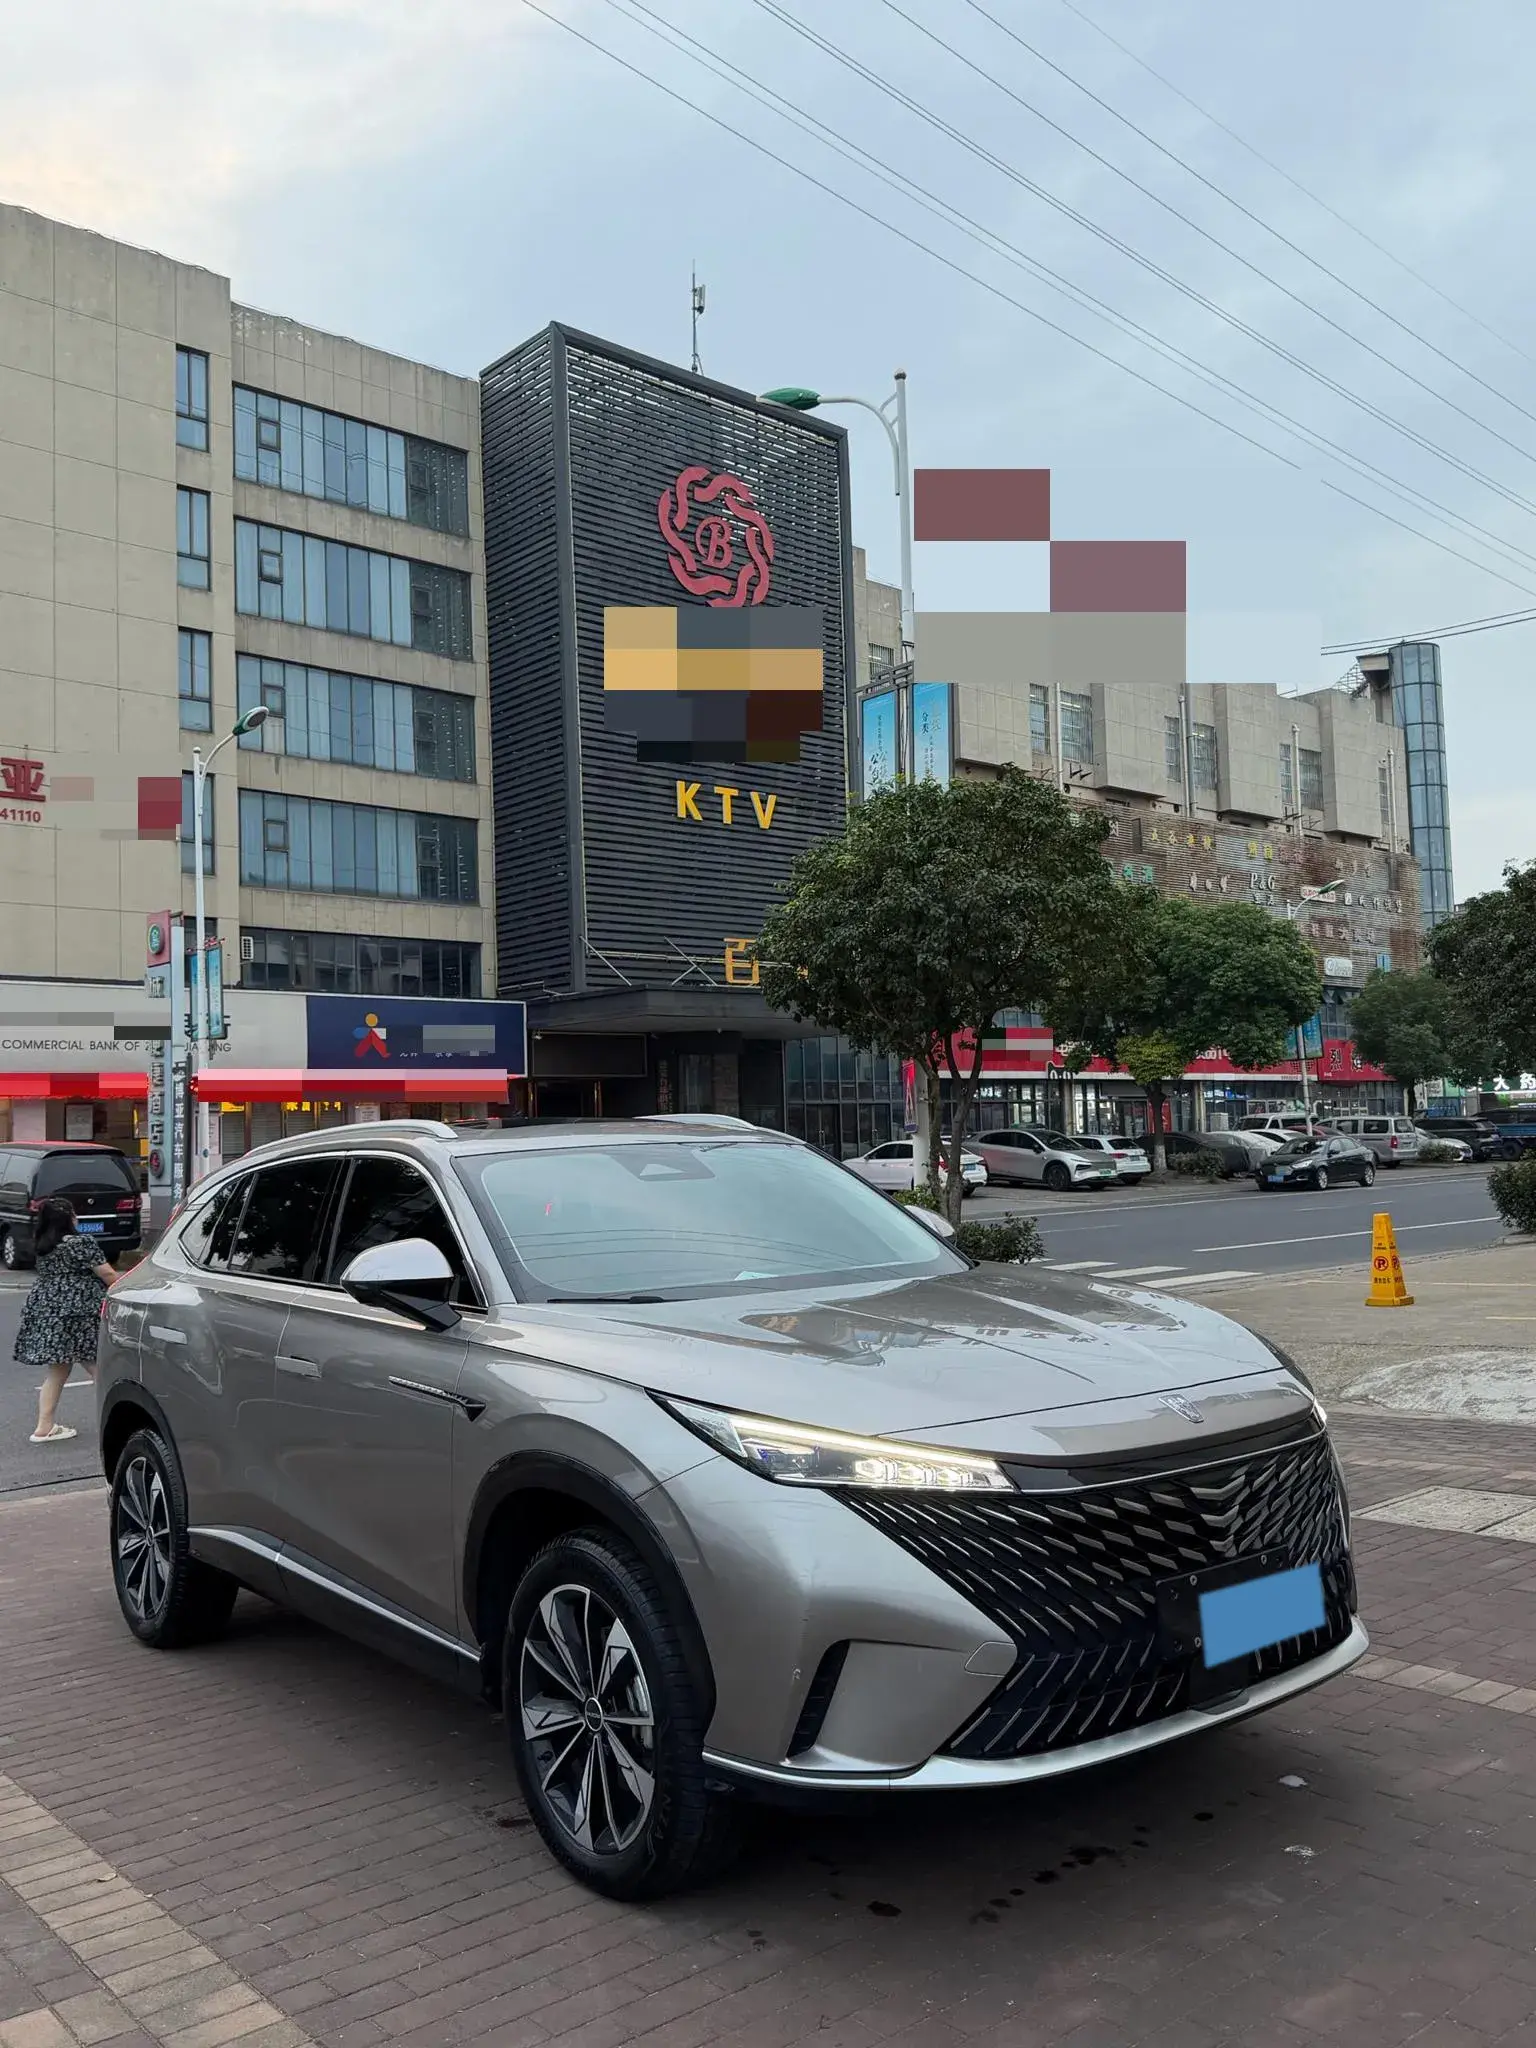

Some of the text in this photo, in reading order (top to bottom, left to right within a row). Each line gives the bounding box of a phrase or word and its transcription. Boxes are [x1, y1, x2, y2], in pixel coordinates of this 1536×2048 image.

[0, 757, 46, 802] 亚
[676, 780, 777, 830] KTV
[2, 1039, 84, 1050] COMMERCIAL
[89, 1040, 119, 1051] BANK
[124, 1041, 140, 1051] OF
